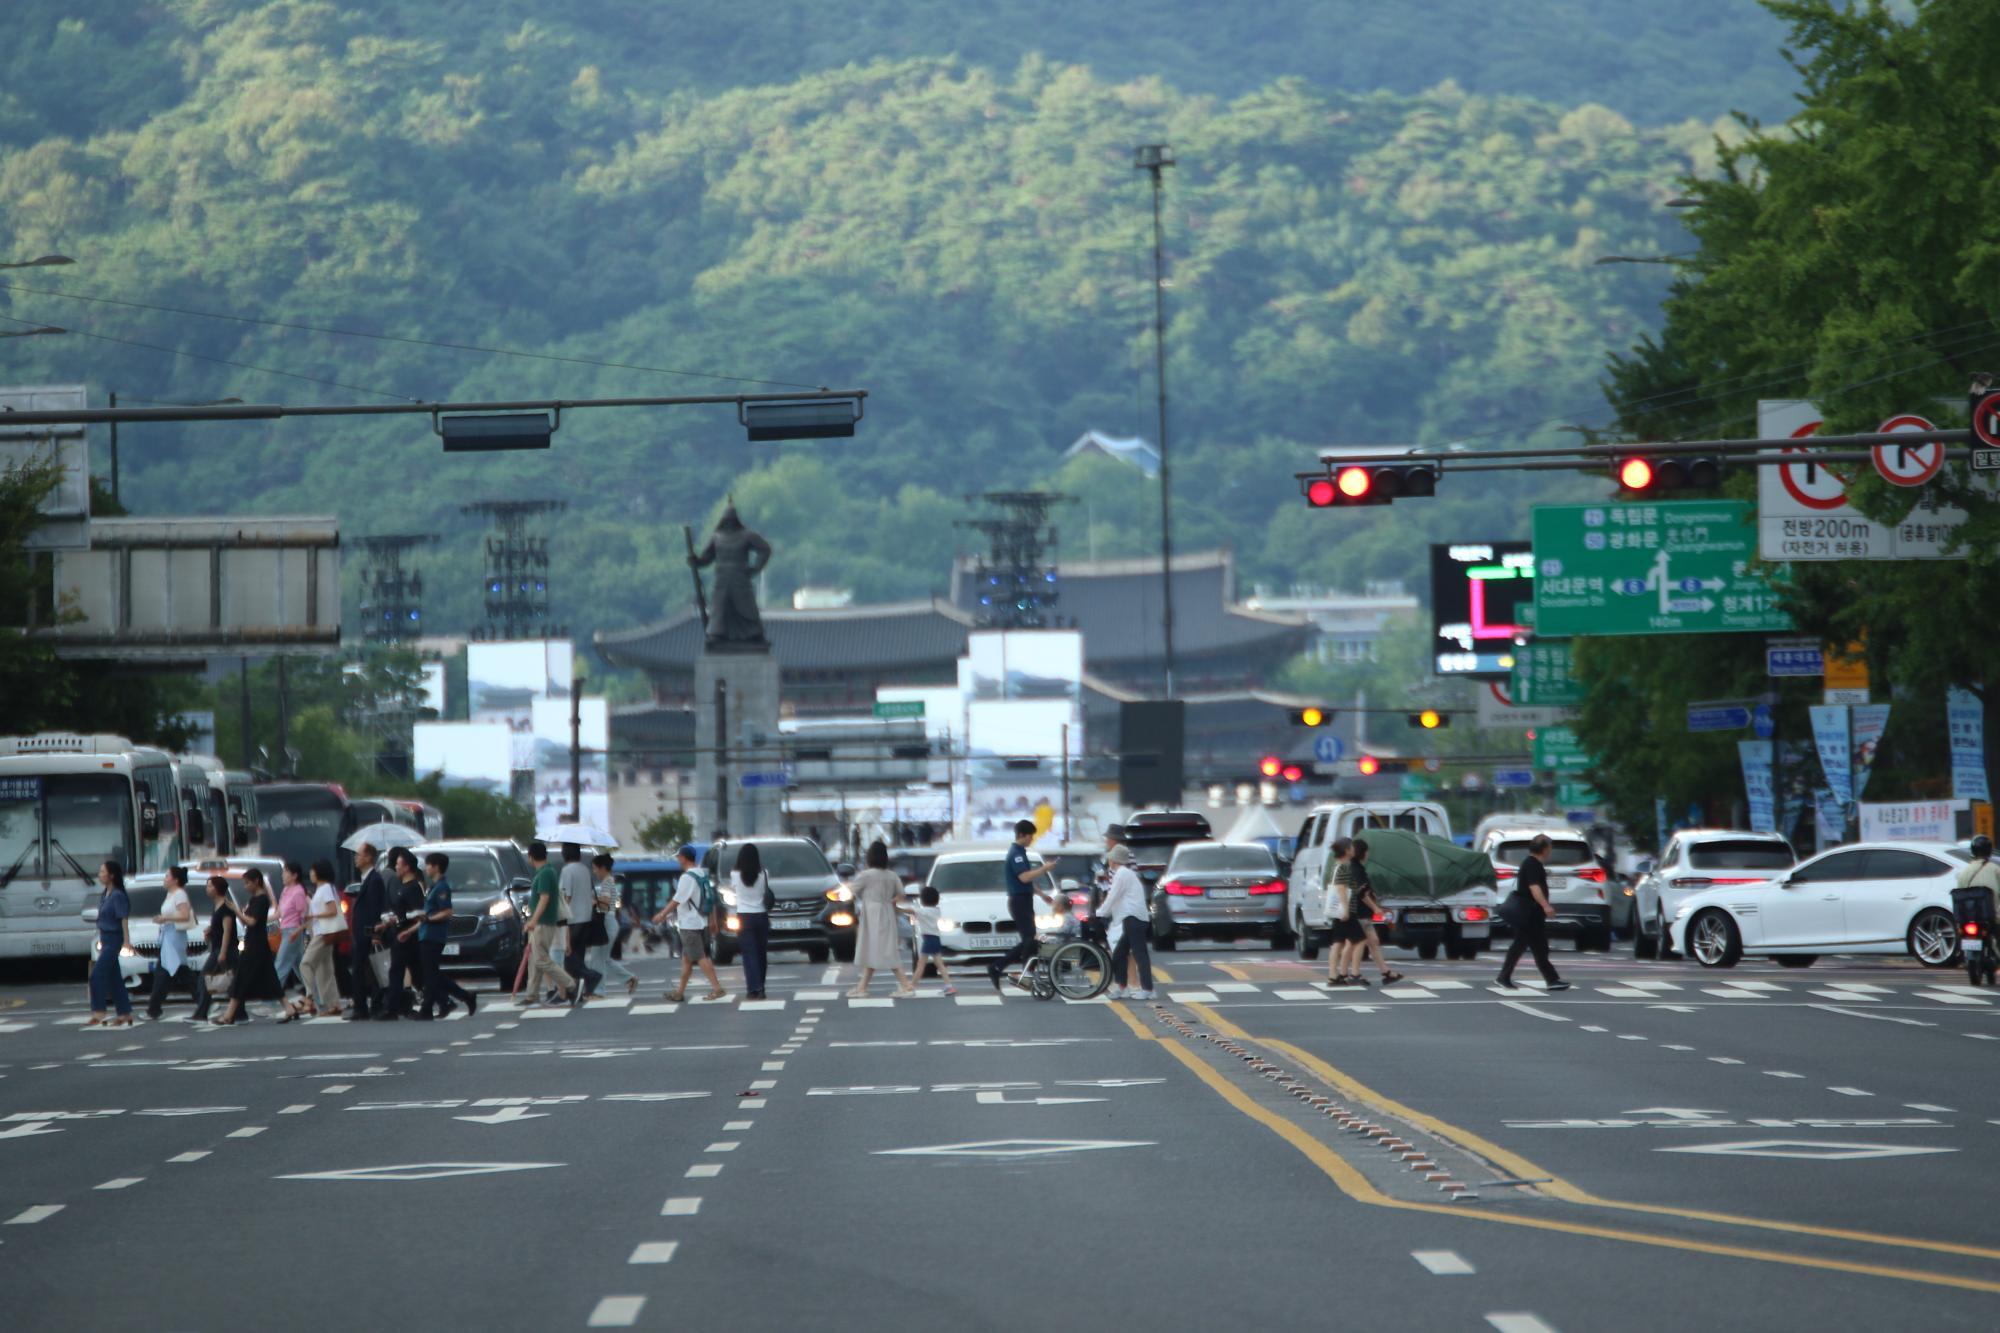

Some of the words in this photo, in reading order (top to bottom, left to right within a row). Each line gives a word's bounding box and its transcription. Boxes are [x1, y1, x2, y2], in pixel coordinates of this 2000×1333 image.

[1609, 508, 1659, 525] 독립문
[1782, 519, 1870, 540] 전방200m
[1609, 531, 1660, 549] 광화문
[1781, 541, 1830, 556] (자전거
[1834, 540, 1870, 556] 허용)
[1541, 577, 1604, 596] 서대문역
